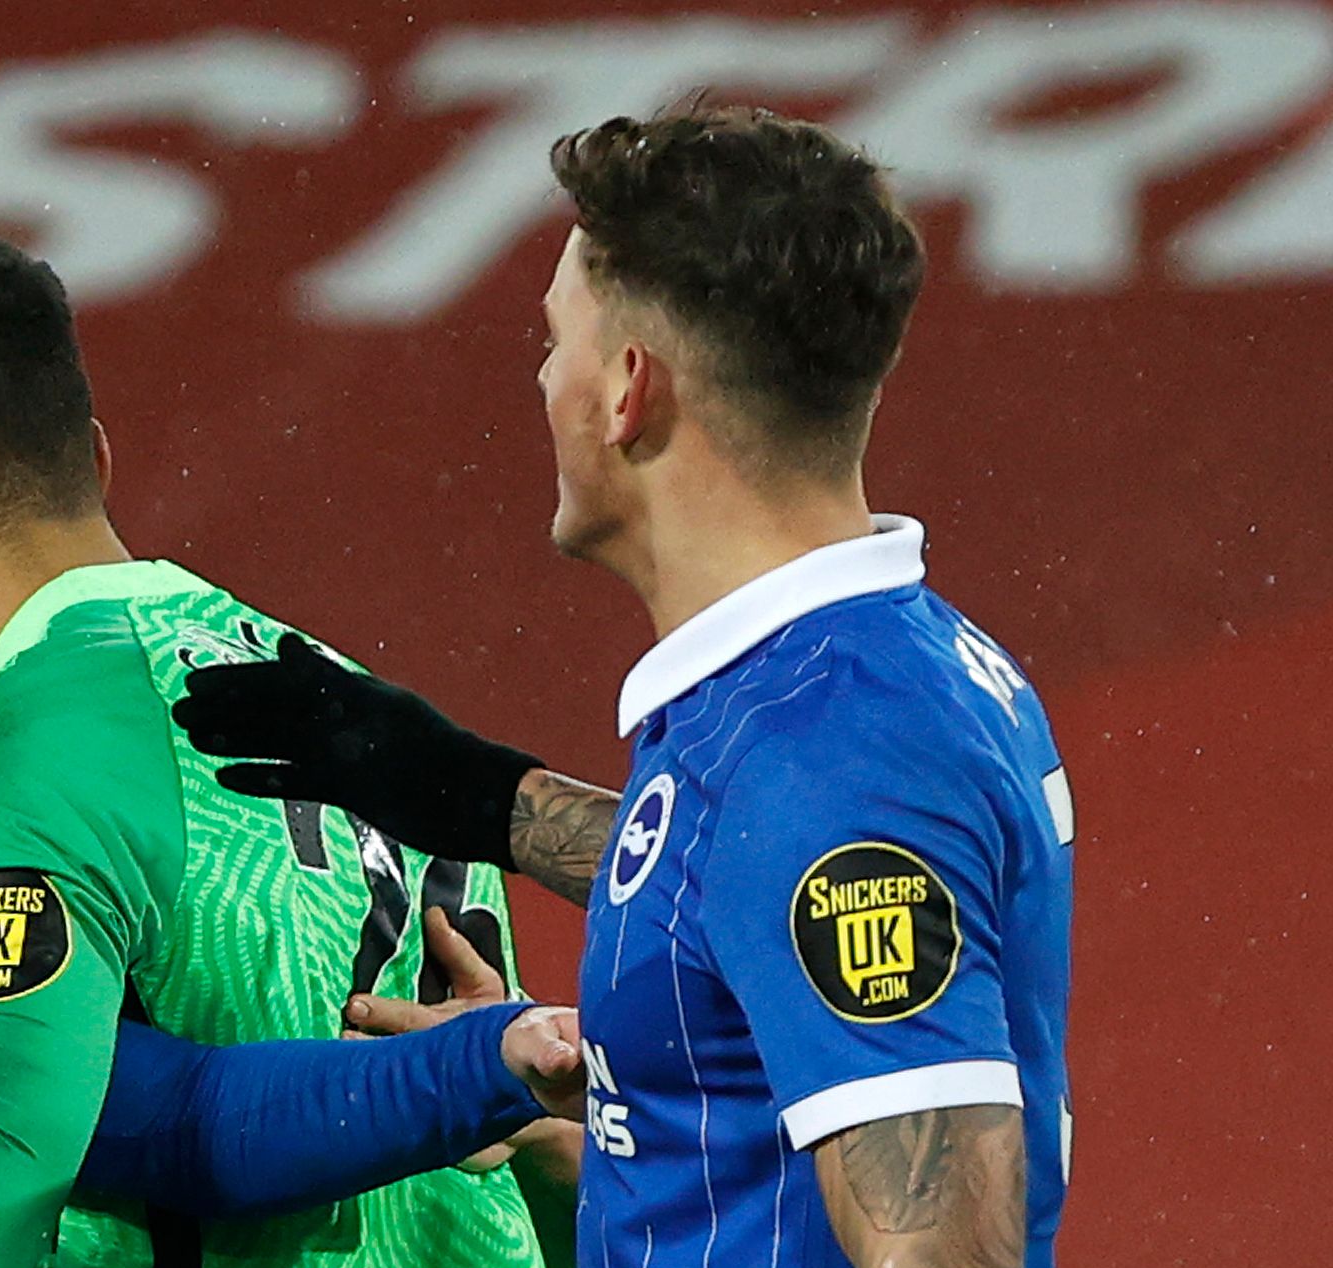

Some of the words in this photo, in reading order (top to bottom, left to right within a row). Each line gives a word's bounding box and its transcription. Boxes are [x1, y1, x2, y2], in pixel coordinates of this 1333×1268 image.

[808, 875, 928, 919] SNICKERS
[848, 913, 903, 970] UK
[862, 975, 909, 1006] .COM
